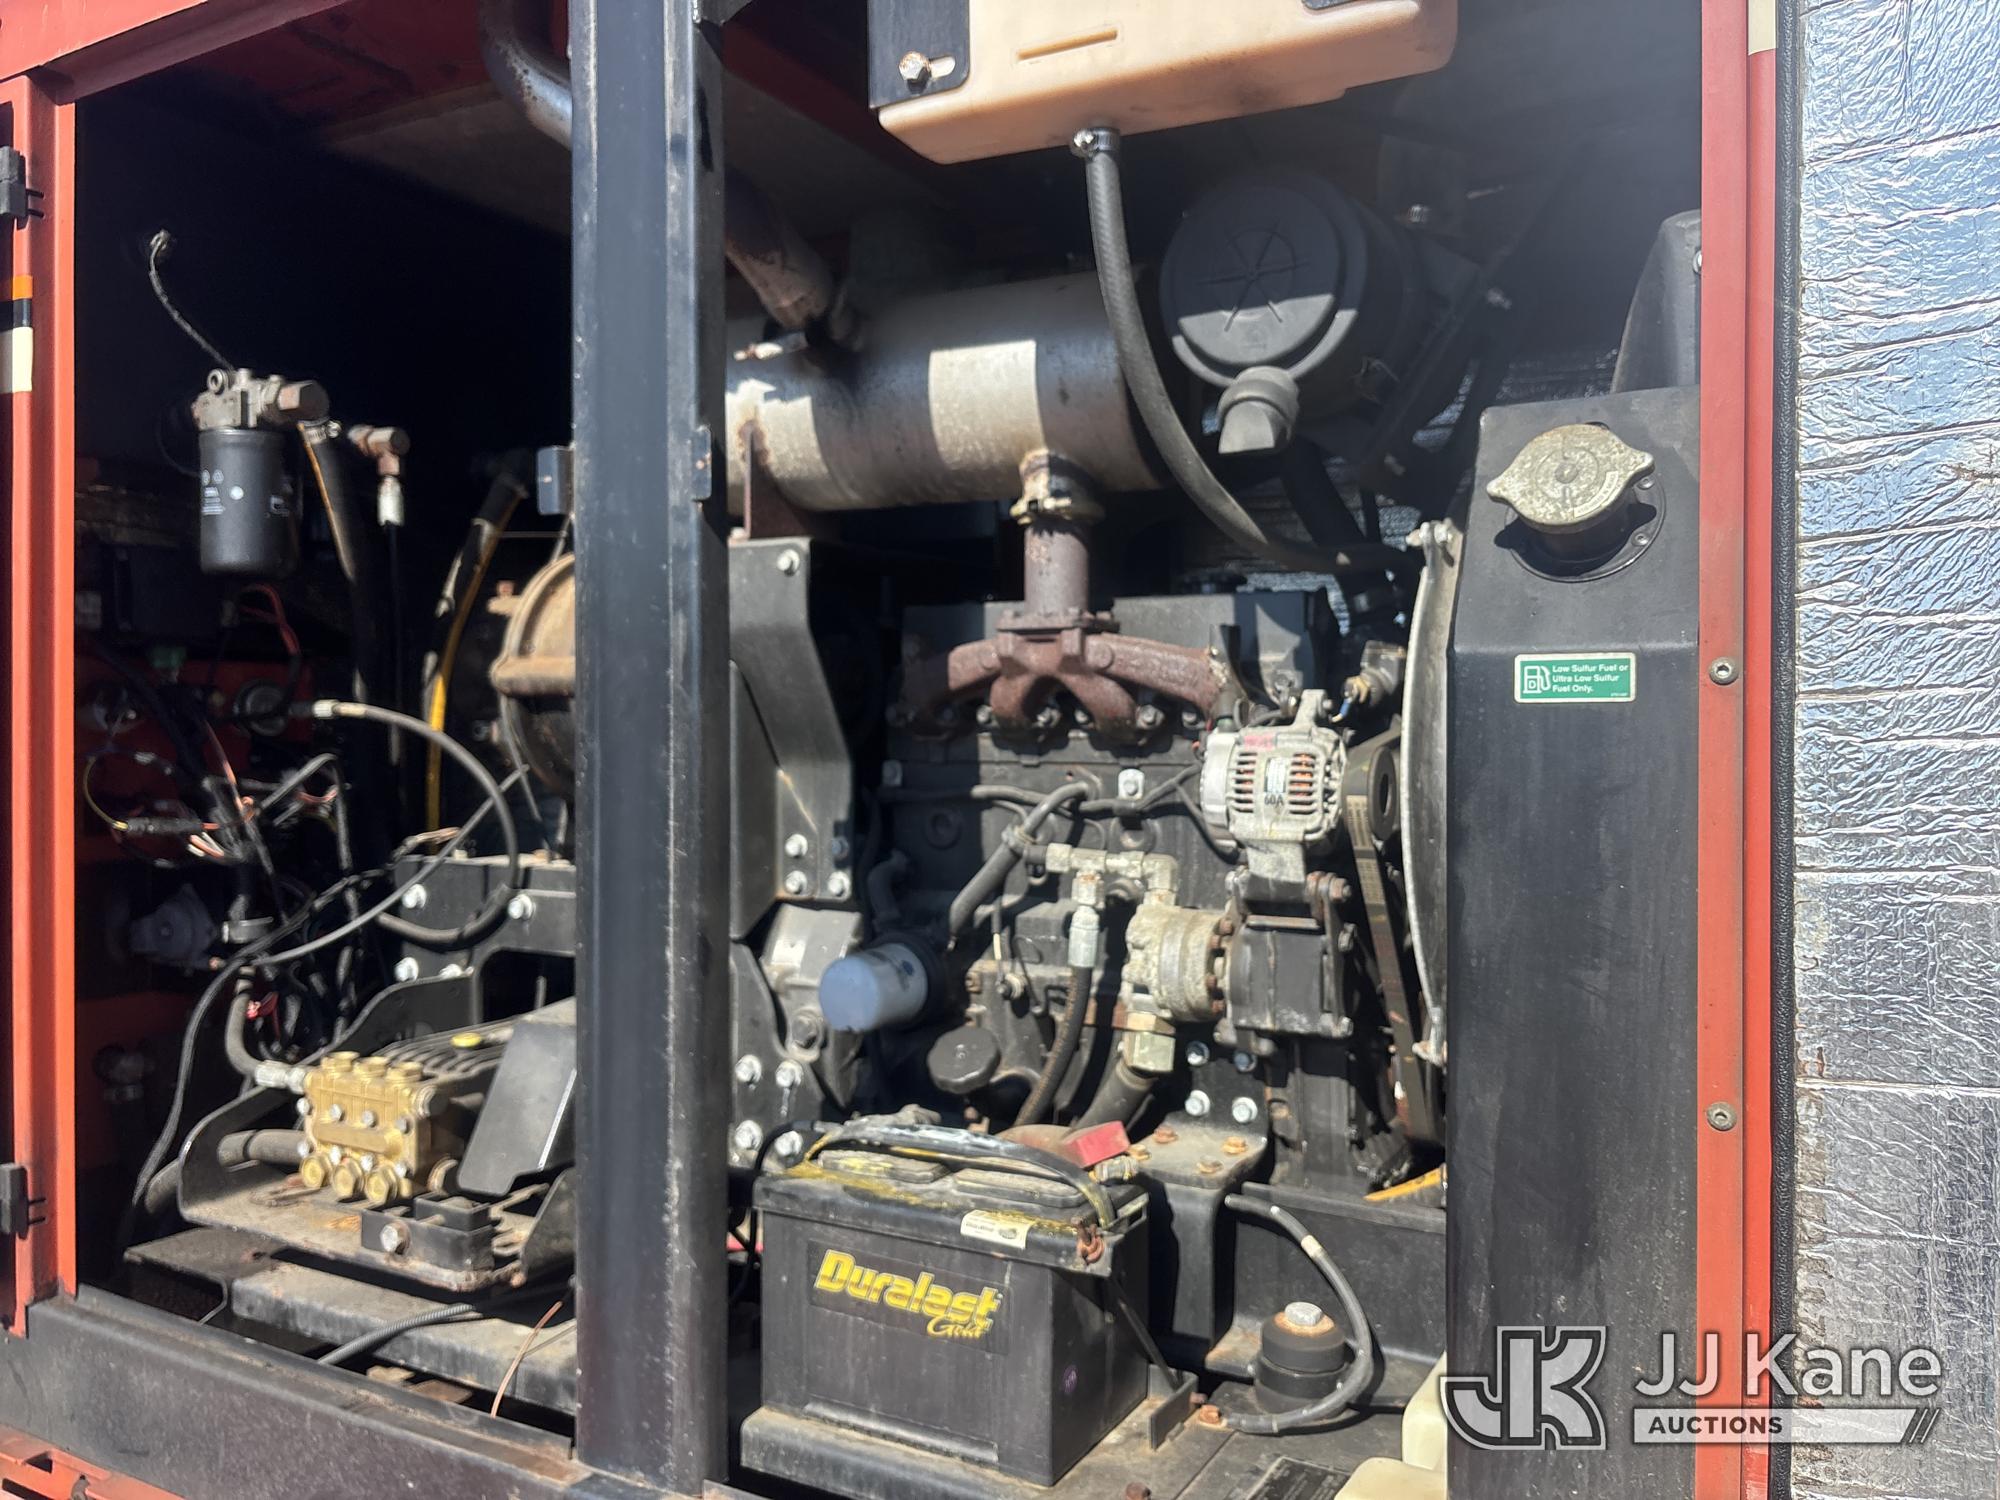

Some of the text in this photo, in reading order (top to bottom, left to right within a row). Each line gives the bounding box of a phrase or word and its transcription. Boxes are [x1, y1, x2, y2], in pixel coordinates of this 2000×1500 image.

[1552, 664, 1629, 673] Low Sulfur Fuel or
[1552, 674, 1620, 683] Ultra Low Sulfur
[1552, 684, 1570, 693] Fuel
[814, 1249, 1000, 1331] Duralast
